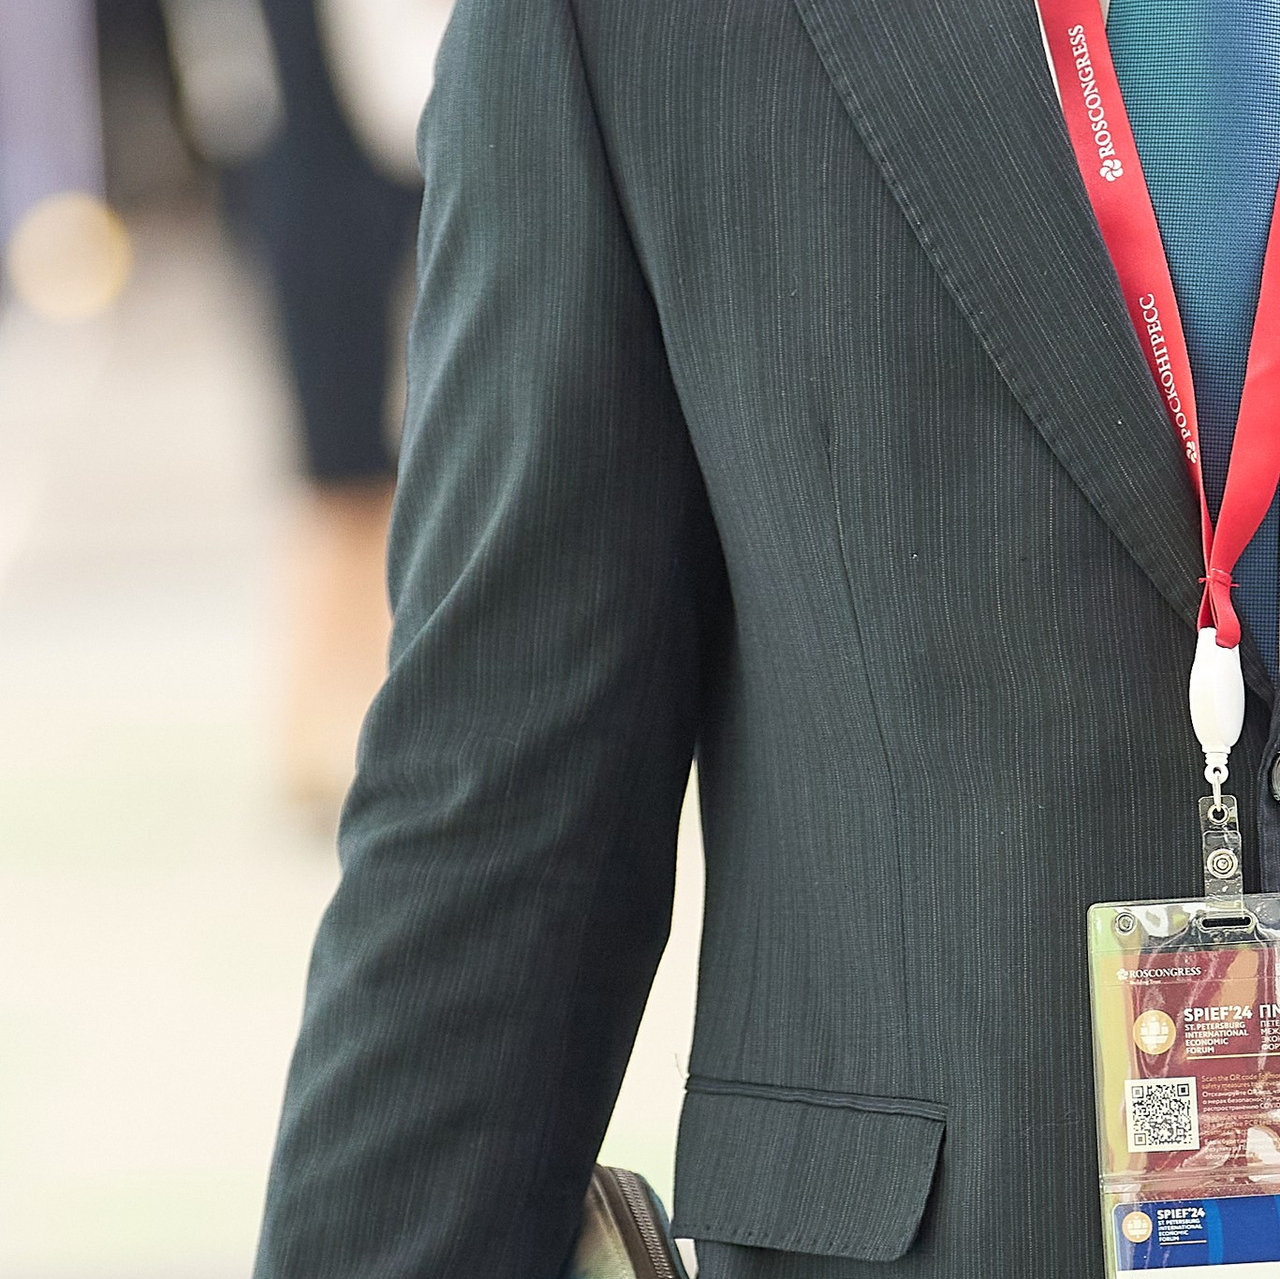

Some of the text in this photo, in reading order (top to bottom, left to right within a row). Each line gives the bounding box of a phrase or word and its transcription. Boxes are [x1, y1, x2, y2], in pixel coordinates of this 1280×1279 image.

[1067, 24, 1116, 159] ROSCONGRESS
[1139, 293, 1191, 440] РОСКОНГРЕСС
[1129, 966, 1202, 979] ROSCONGRESS
[1197, 1022, 1246, 1030] PETERSBURG
[1185, 1029, 1249, 1038] INTERNATIONAL
[1185, 1038, 1229, 1046] ECONOMIC
[1186, 1046, 1215, 1054] FORUM
